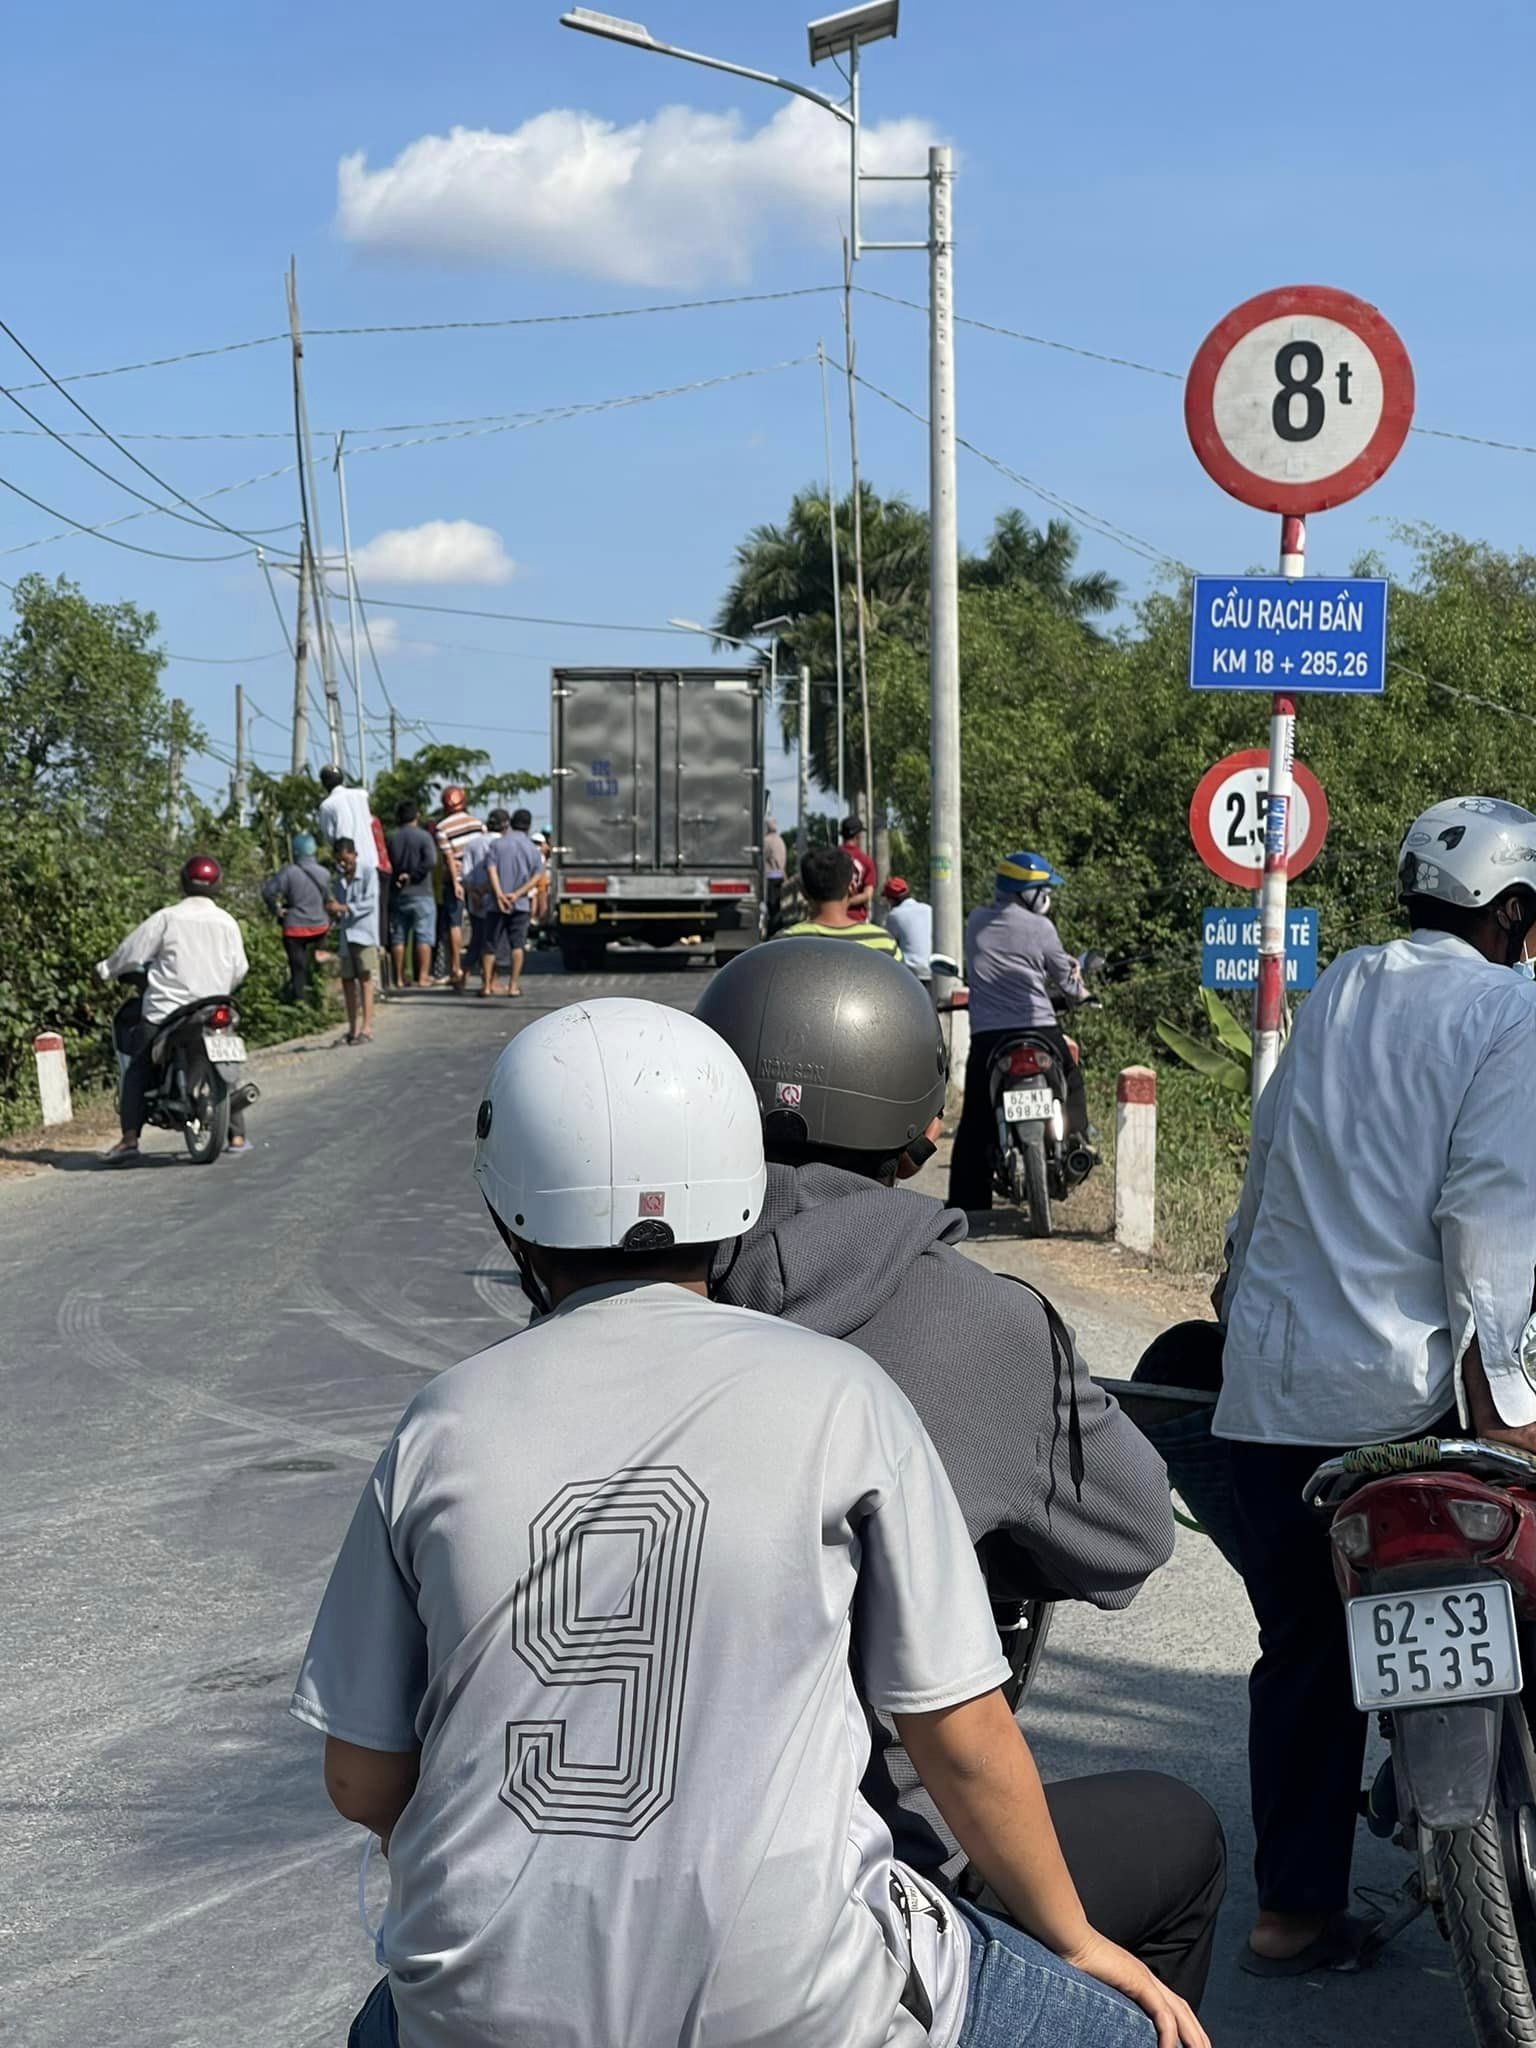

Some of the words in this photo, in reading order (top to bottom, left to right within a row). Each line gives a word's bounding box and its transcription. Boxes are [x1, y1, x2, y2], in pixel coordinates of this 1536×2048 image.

[1210, 585, 1253, 629] CẦU
[1257, 598, 1314, 636] RẠCH
[1319, 588, 1364, 633] BẦN
[1212, 647, 1247, 674] KM
[1254, 648, 1275, 675] 18
[1280, 656, 1295, 676] +
[1300, 650, 1369, 678] 285,26
[1373, 1592, 1488, 1647] 62-S3
[498, 1465, 710, 1841] 9
[1377, 1641, 1494, 1698] 5535
